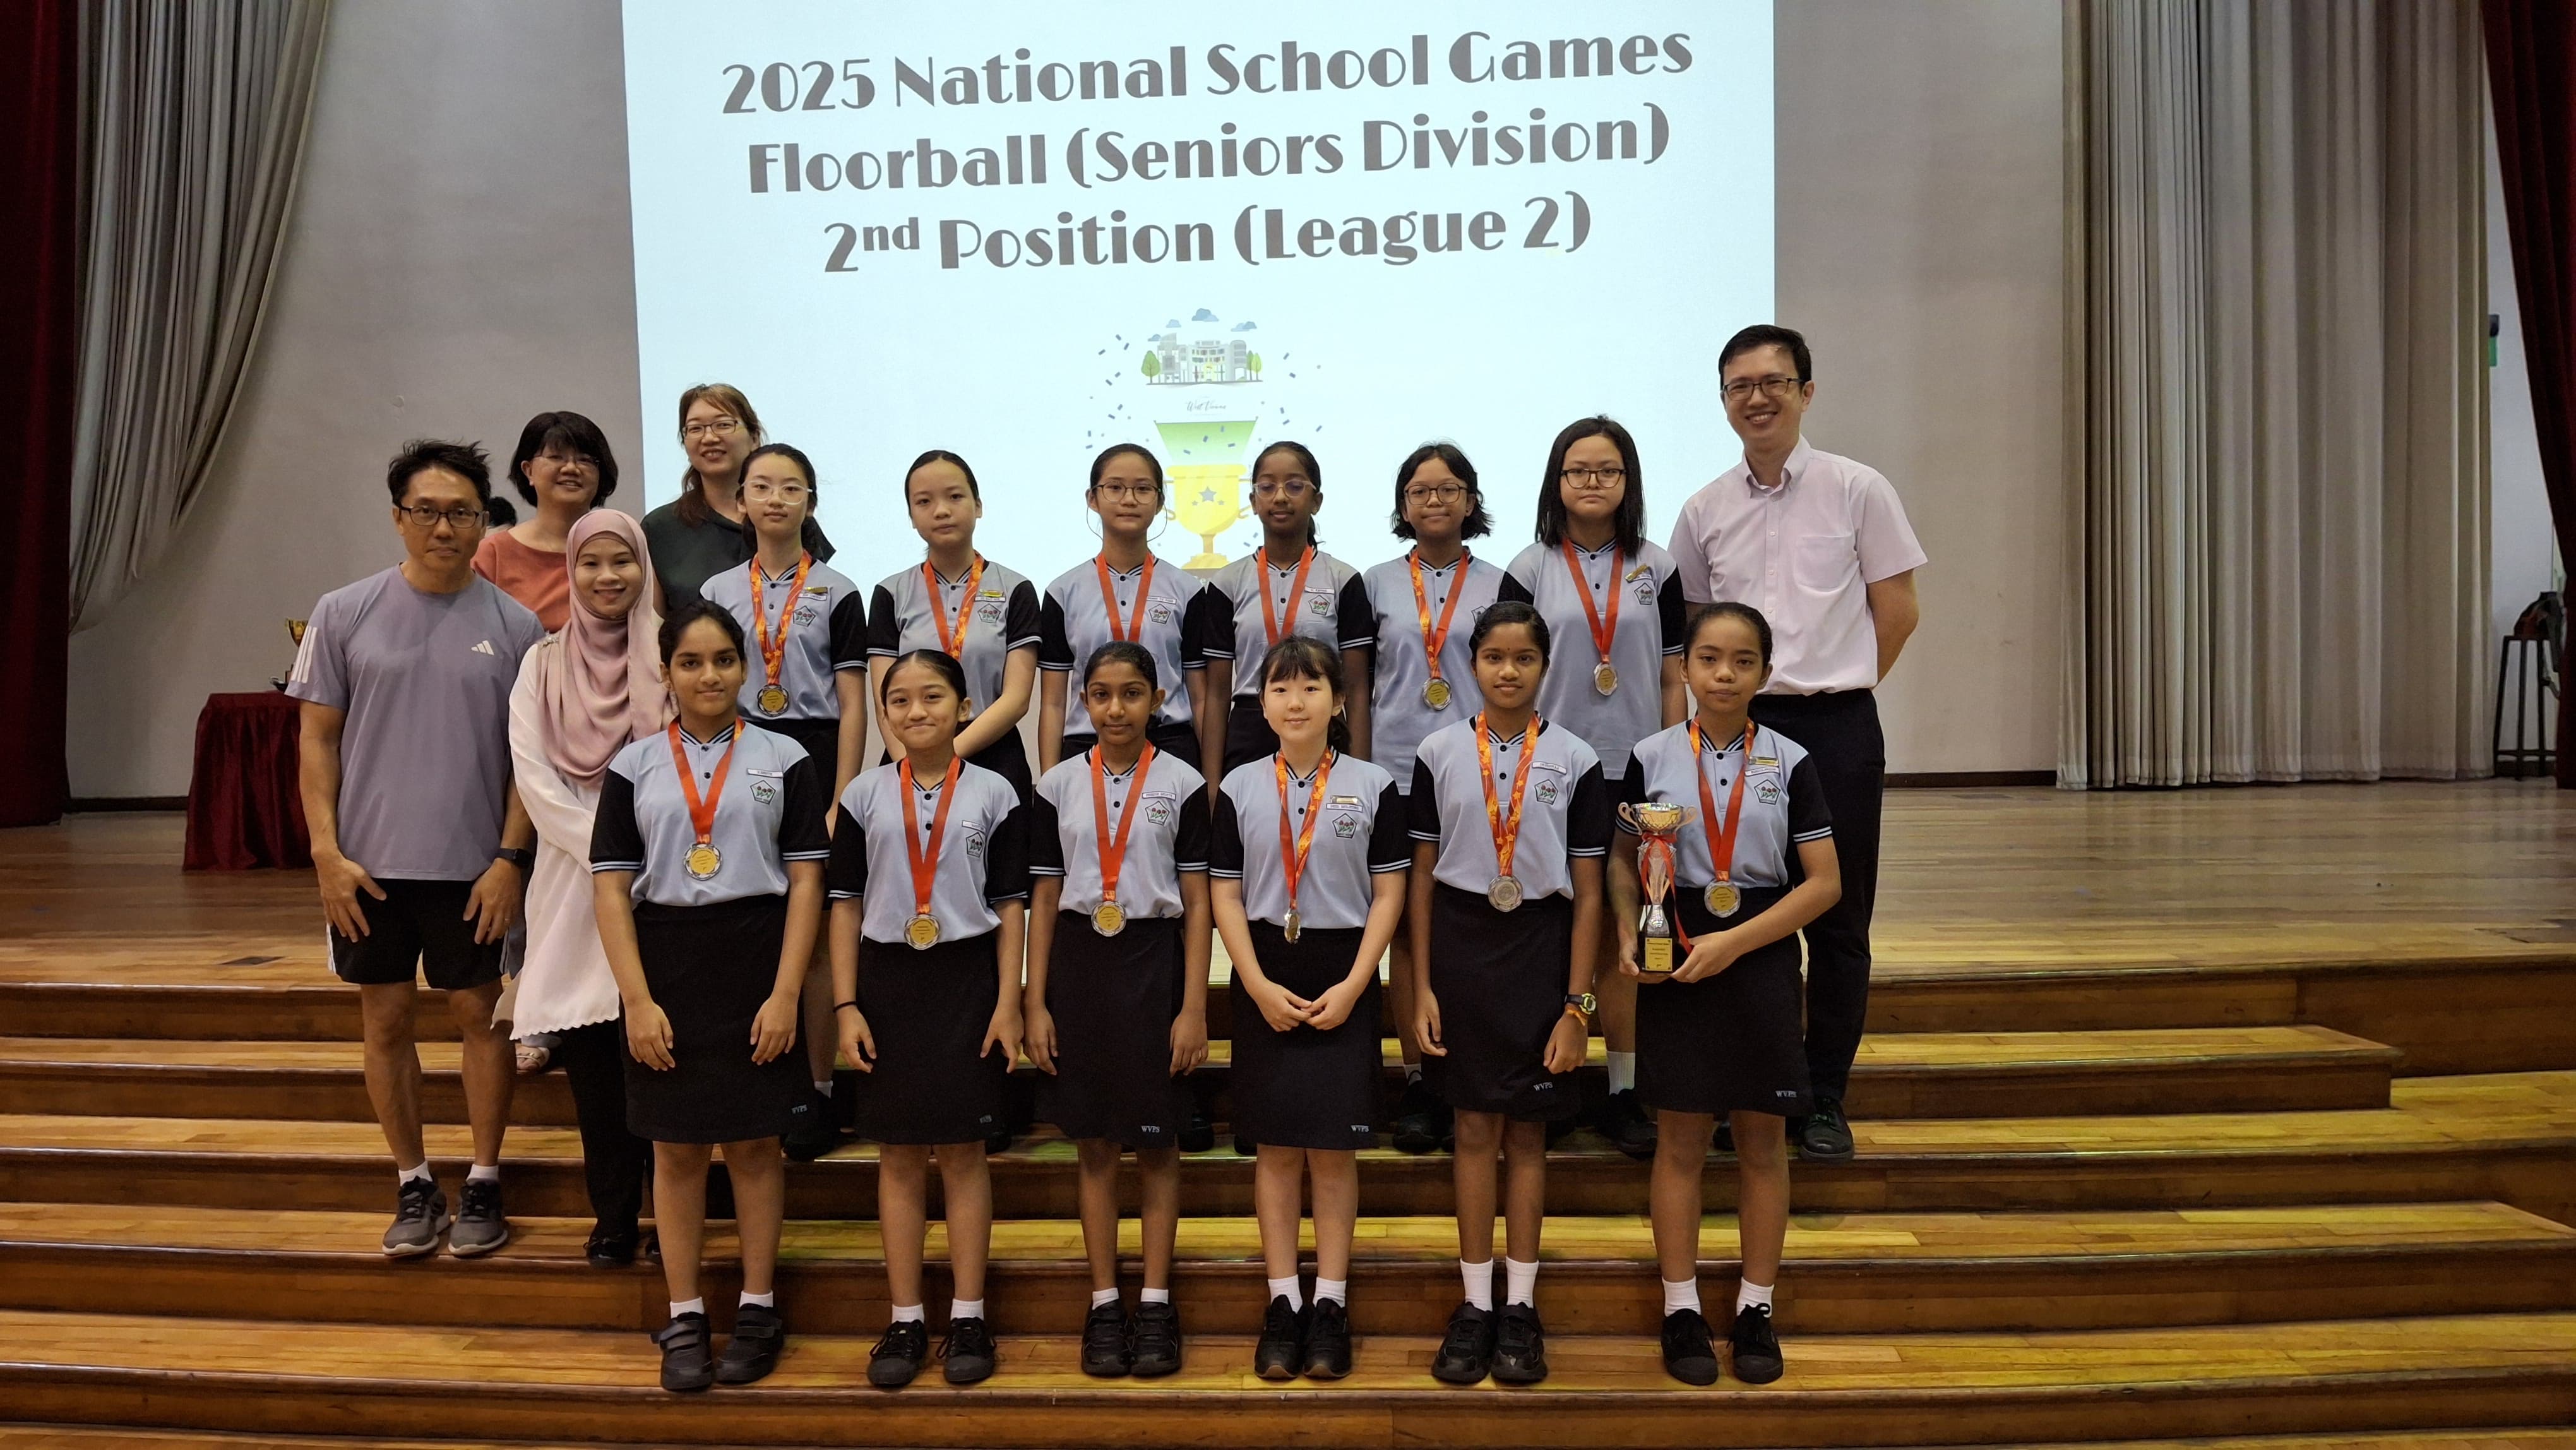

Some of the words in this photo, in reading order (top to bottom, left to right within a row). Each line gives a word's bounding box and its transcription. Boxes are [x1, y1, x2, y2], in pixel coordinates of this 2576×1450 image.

[722, 59, 875, 114] 2025
[895, 46, 1187, 107] National
[1207, 35, 1429, 95] School
[1448, 32, 1693, 83] Games
[749, 135, 1047, 193] Floorball
[1066, 123, 1344, 188] (Seniors
[1363, 102, 1669, 171] Division)
[824, 217, 920, 273] 2nd
[939, 210, 1214, 269] Position
[1234, 209, 1506, 265] (League
[1523, 191, 1590, 253] 2)
[1534, 1082, 1553, 1091] WVPS
